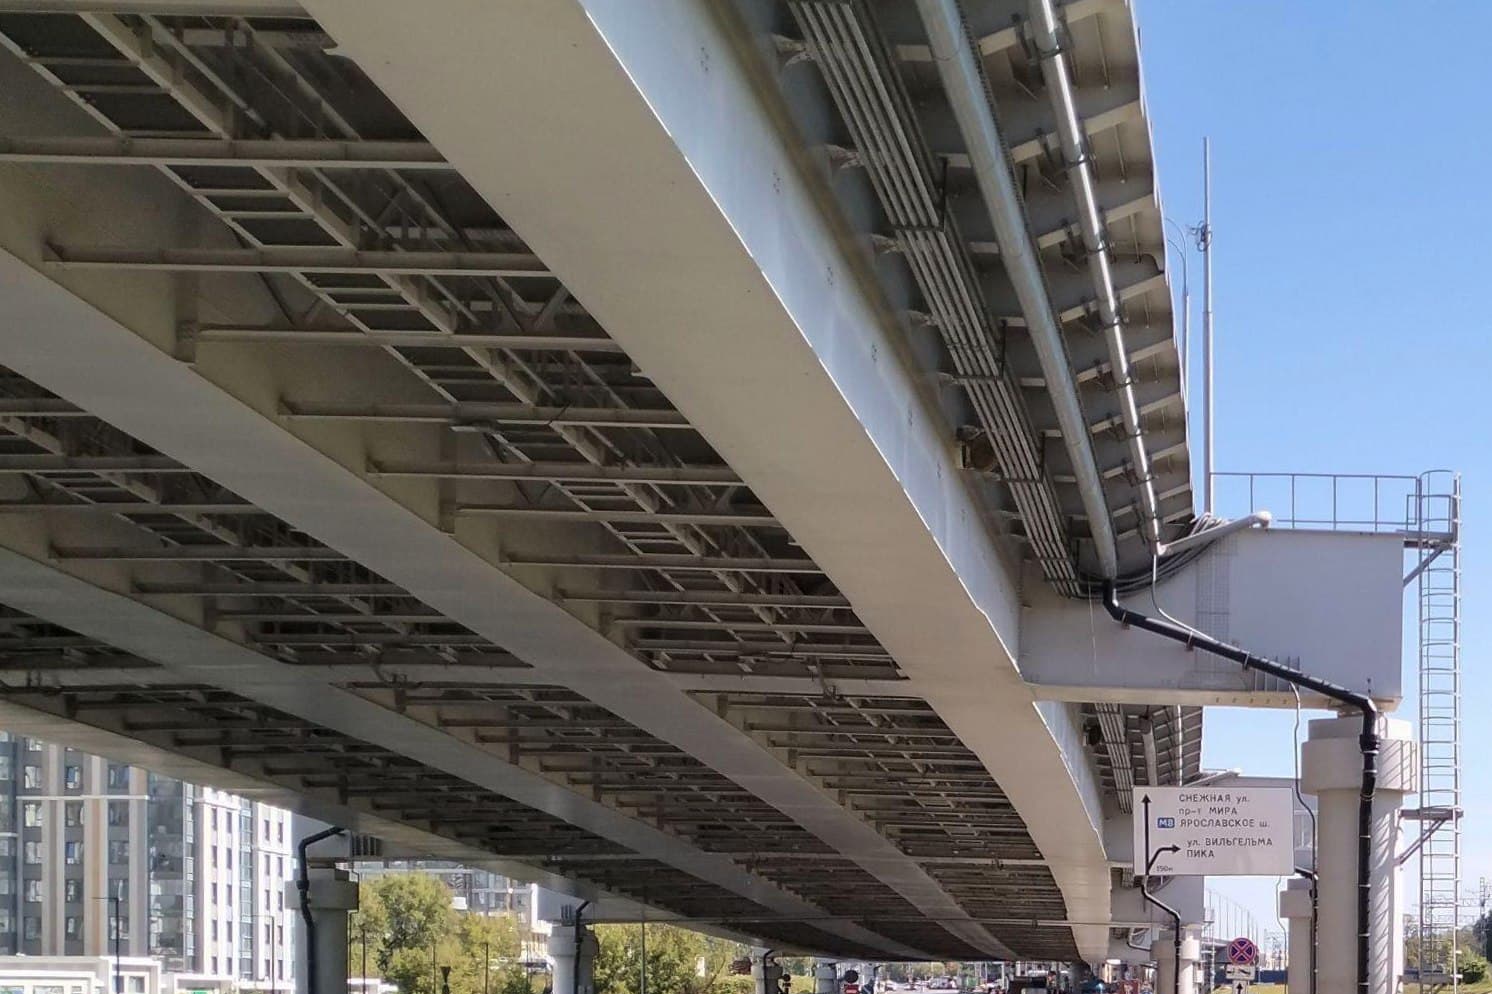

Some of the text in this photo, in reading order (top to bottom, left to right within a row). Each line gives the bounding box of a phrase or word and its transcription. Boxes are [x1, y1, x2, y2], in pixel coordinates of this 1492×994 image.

[1178, 793, 1250, 804] СНЕЖНАЯ ул.
[1178, 807, 1238, 816] пр-т МИРА
[1180, 818, 1255, 828] ЯРОСЛАВСКОЕ
[1186, 837, 1273, 848] ул. ВИЛЬГЕЛЬМА
[1186, 849, 1215, 858] ПИКА
